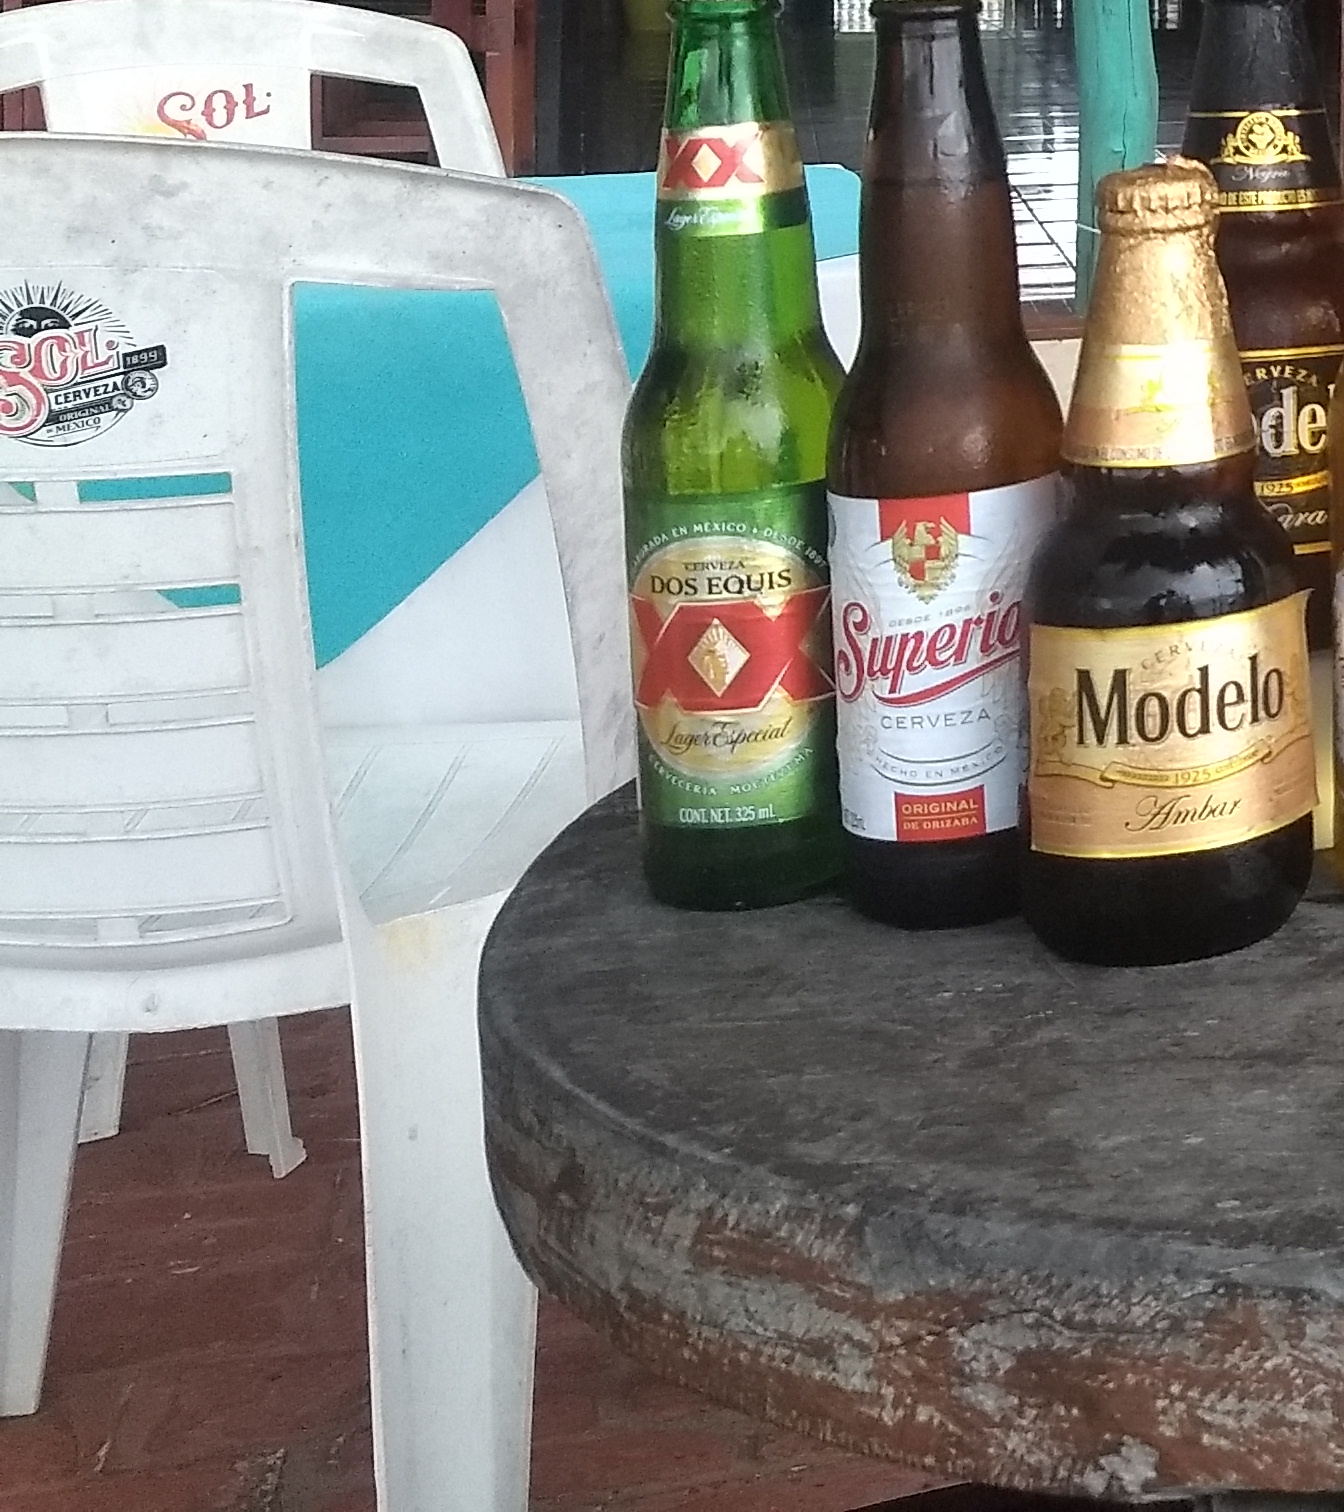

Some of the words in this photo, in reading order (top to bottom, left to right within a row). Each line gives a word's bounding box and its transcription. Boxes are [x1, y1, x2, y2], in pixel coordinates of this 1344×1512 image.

[125, 349, 159, 365] 1899
[1243, 365, 1318, 388] ERVEZA
[54, 381, 121, 406] CERVEZA
[59, 402, 111, 422] ORIGINAL
[55, 416, 102, 434] MEXICO
[671, 526, 687, 538] EN
[763, 527, 806, 551] DESDE
[682, 560, 746, 572] CERVEZA
[650, 575, 698, 596] DOS
[706, 568, 792, 596] EQUIS
[888, 615, 931, 628] DESDE
[838, 591, 1022, 703] Superio
[1074, 652, 1285, 749] Modelo
[881, 708, 992, 730] CERVEZA
[661, 723, 711, 755] Lager
[712, 716, 793, 754] Especial
[876, 756, 918, 778] HECHO
[925, 770, 943, 778] EN
[1175, 768, 1211, 785] 1925
[709, 807, 733, 823] NET.
[735, 805, 755, 820] 325
[901, 799, 979, 815] ORIGINAL
[1125, 794, 1242, 832] Ambar
[903, 820, 919, 830] DE
[922, 816, 978, 830] ORIZABA
